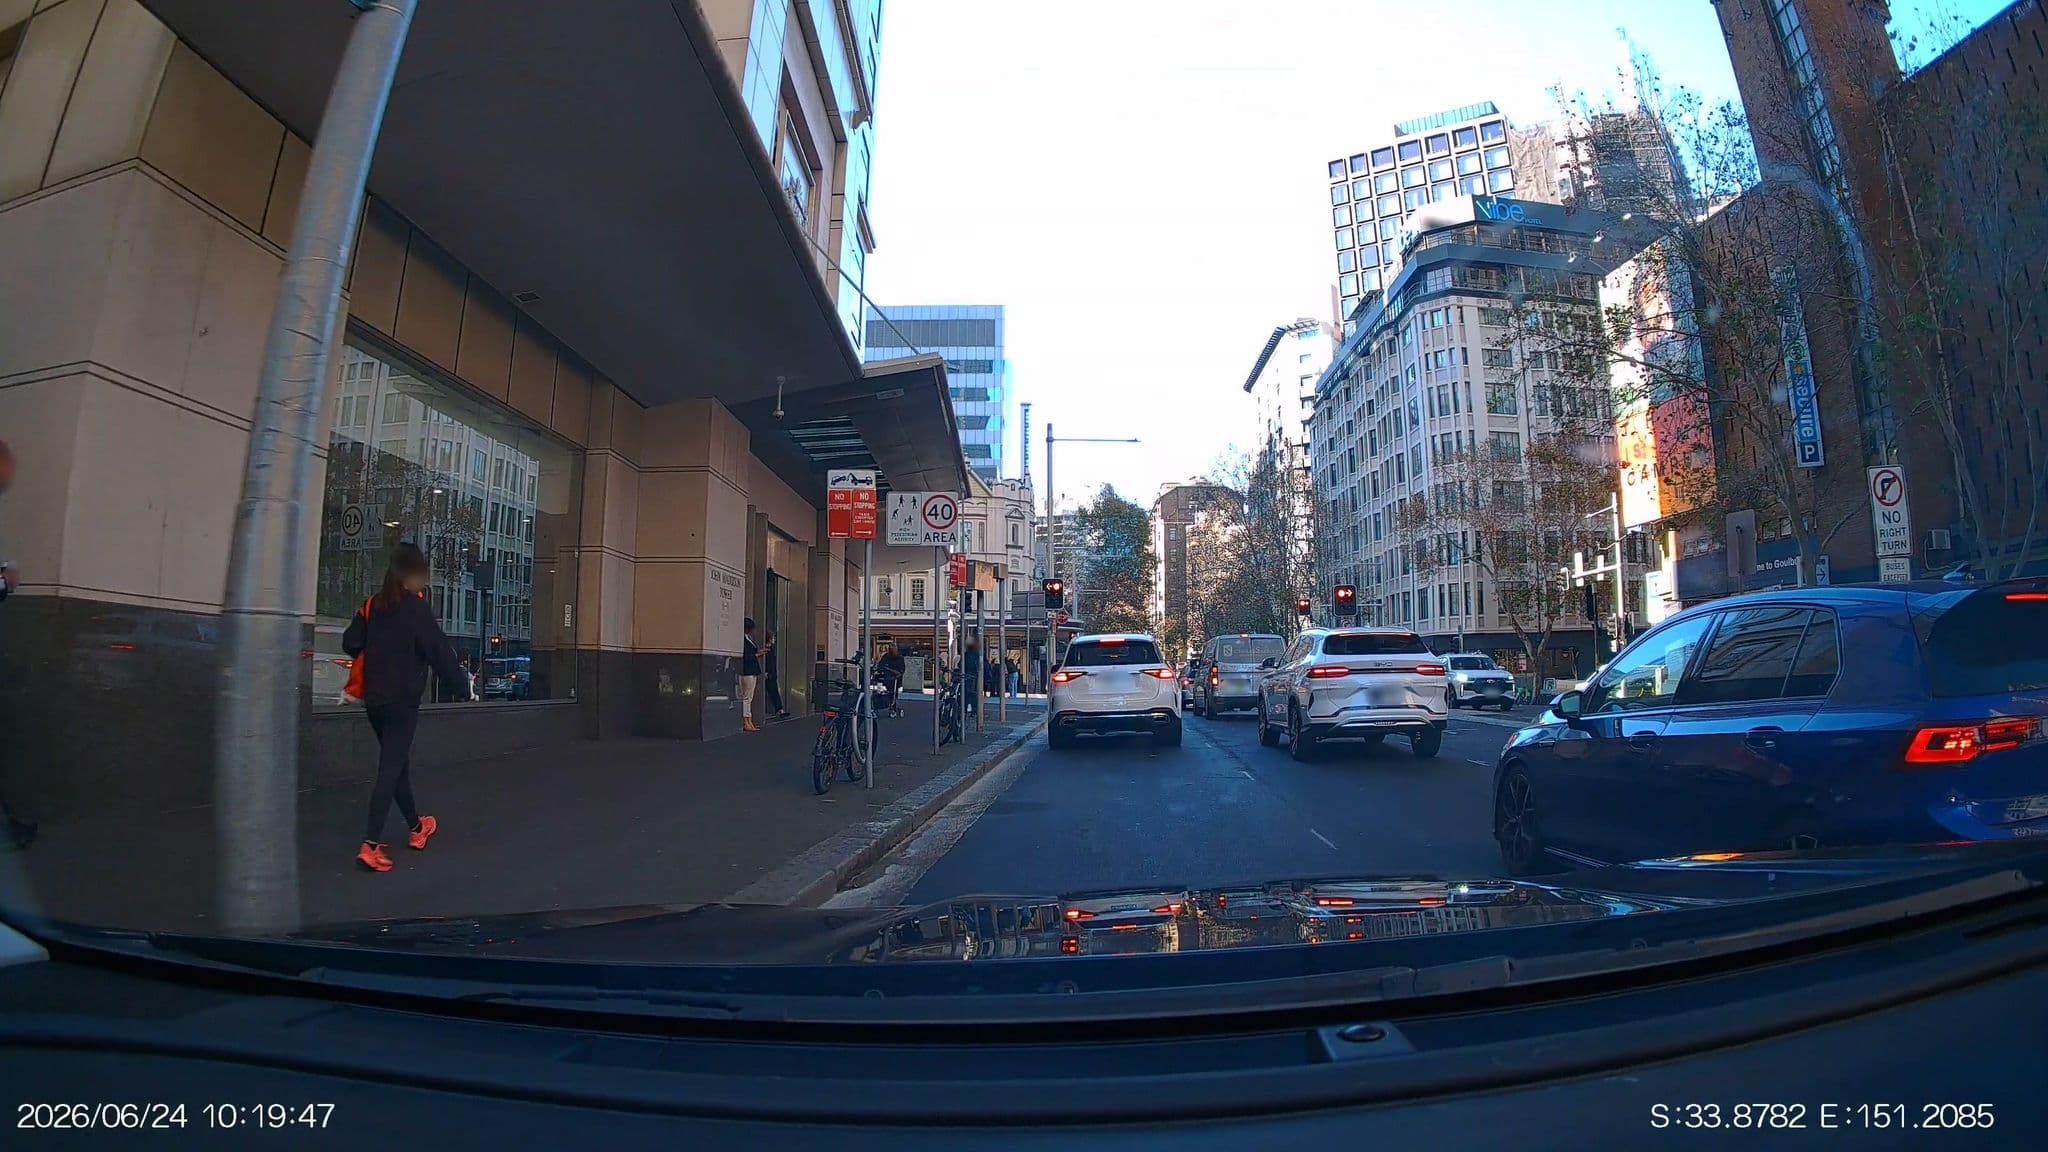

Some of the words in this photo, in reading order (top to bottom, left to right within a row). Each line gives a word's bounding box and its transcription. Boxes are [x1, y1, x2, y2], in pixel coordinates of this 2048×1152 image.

[1475, 195, 1525, 222] Vibe
[1794, 376, 1816, 438] secure
[1804, 444, 1815, 460] P
[834, 493, 845, 501] NO
[859, 492, 869, 501] NO
[927, 503, 953, 521] 40
[1882, 511, 1901, 524] NO
[923, 532, 957, 543] AREA
[1880, 527, 1907, 538] RIGHT
[1882, 540, 1907, 552] TURN
[1766, 561, 1773, 570] to
[1885, 562, 1905, 571] BUSES
